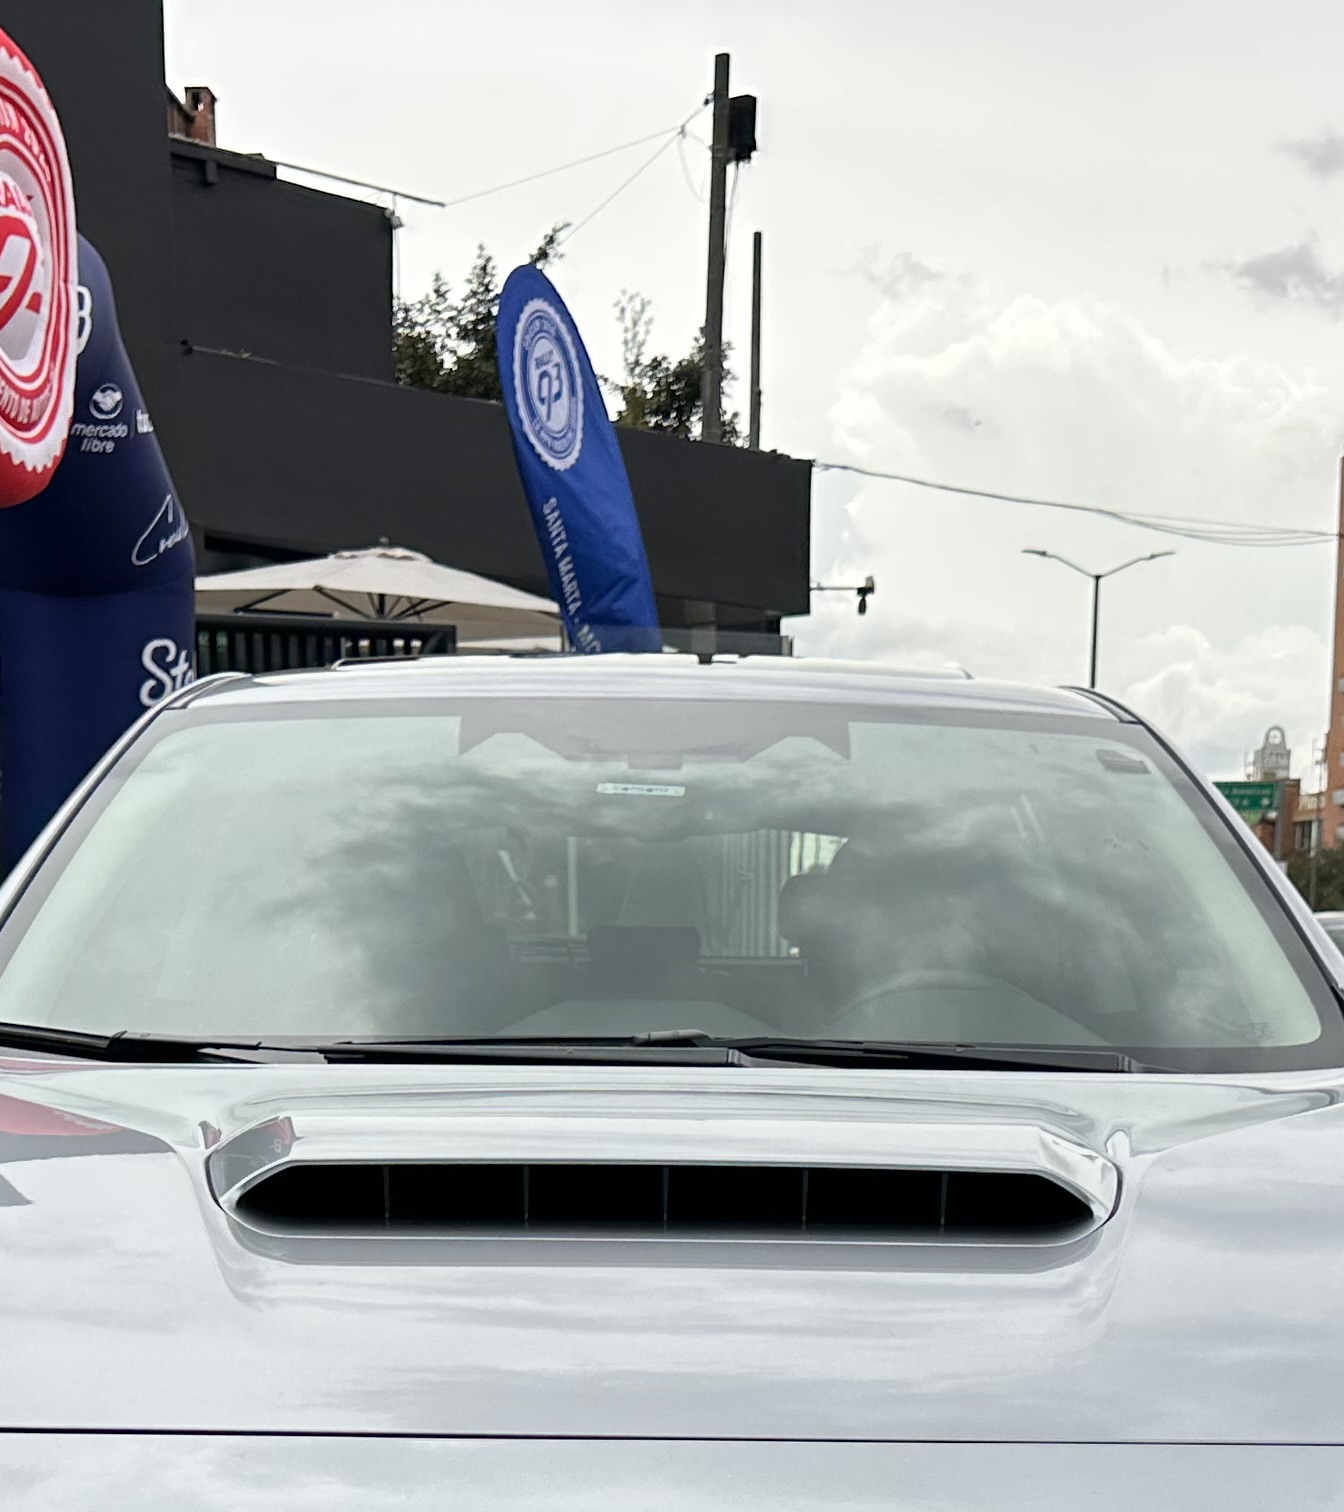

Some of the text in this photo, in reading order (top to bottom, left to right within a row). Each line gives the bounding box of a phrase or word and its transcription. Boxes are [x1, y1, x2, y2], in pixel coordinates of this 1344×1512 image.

[538, 363, 563, 423] 93
[70, 422, 128, 438] mercado
[80, 438, 115, 454] libre
[542, 496, 569, 560] SANTA
[558, 555, 583, 617] MARTA
